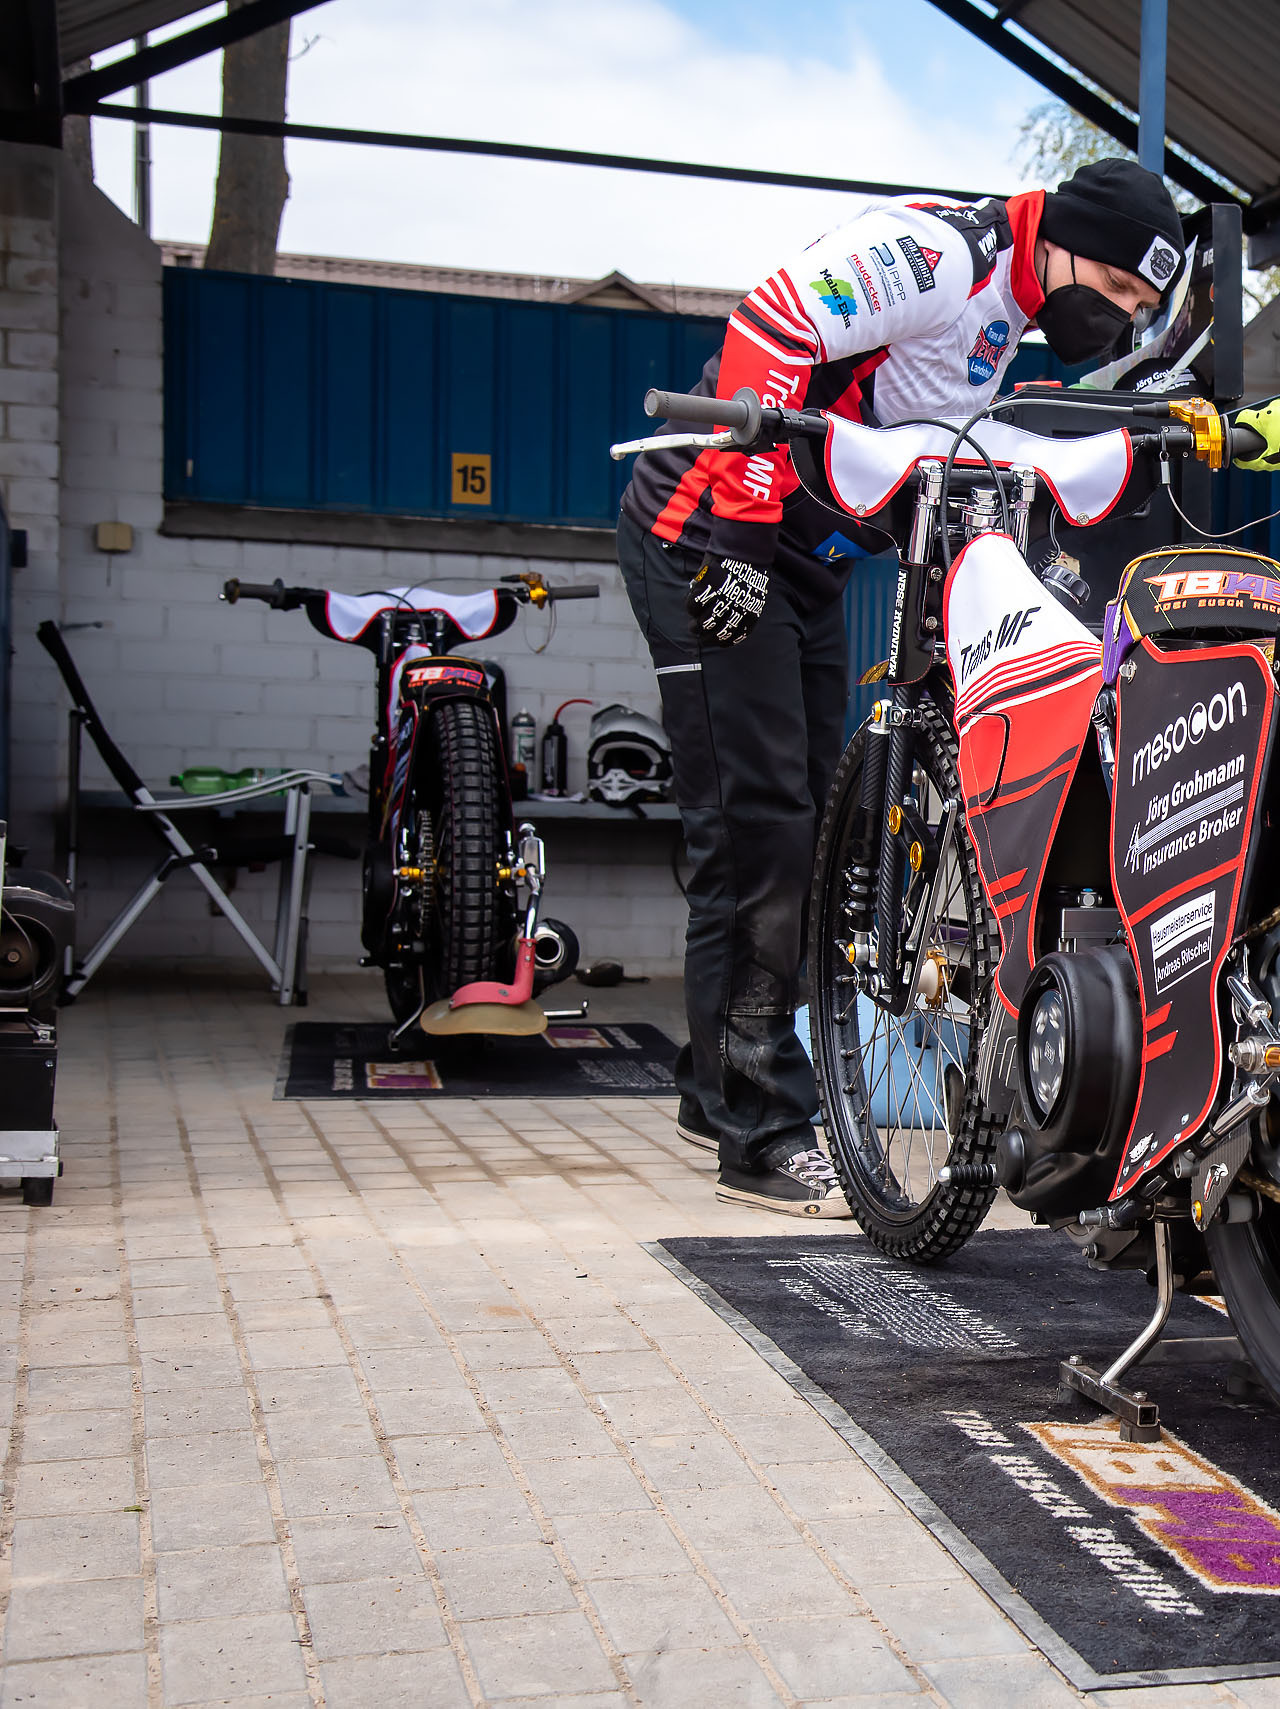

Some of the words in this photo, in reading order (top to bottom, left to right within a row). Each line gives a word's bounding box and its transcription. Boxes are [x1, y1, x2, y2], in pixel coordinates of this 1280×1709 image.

[820, 268, 843, 301] Maler
[837, 300, 852, 330] Eiba
[850, 253, 882, 312] neudecker
[761, 369, 800, 410] Tra
[456, 465, 486, 494] 15
[742, 455, 775, 501] MF
[1154, 599, 1188, 614] TOBI
[1197, 597, 1244, 609] BUSCH
[960, 630, 993, 686] Trans
[994, 606, 1042, 653] MF
[1131, 681, 1248, 787] mesocon
[1145, 795, 1170, 826] Jörg
[1171, 753, 1245, 807] Grohmann
[1143, 829, 1197, 876] Insurance
[1197, 806, 1244, 845] Broker
[1152, 902, 1213, 946] Hausmeisterservice
[1156, 956, 1181, 983] Andreas
[1180, 935, 1211, 967] Ritschel
